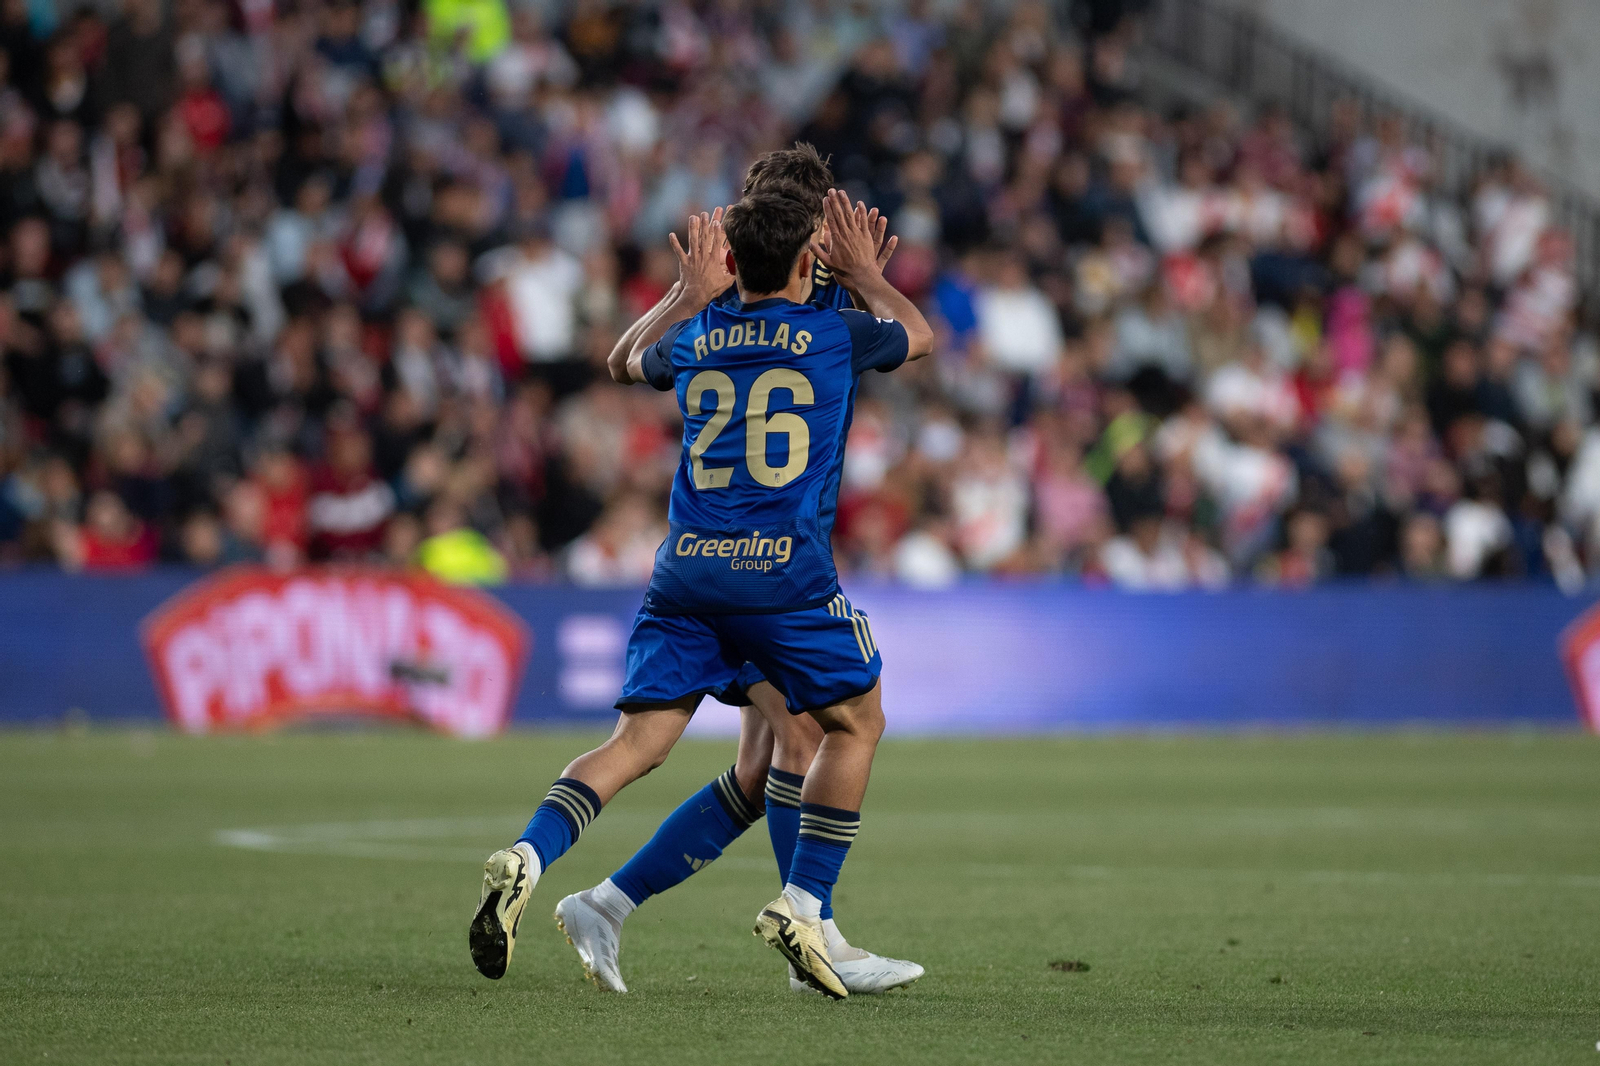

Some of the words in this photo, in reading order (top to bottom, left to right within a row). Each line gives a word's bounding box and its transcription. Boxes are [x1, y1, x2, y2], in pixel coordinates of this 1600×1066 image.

[693, 319, 813, 362] RODELAS
[686, 367, 815, 490] 26
[675, 531, 793, 563] Greening
[730, 558, 773, 573] Group
